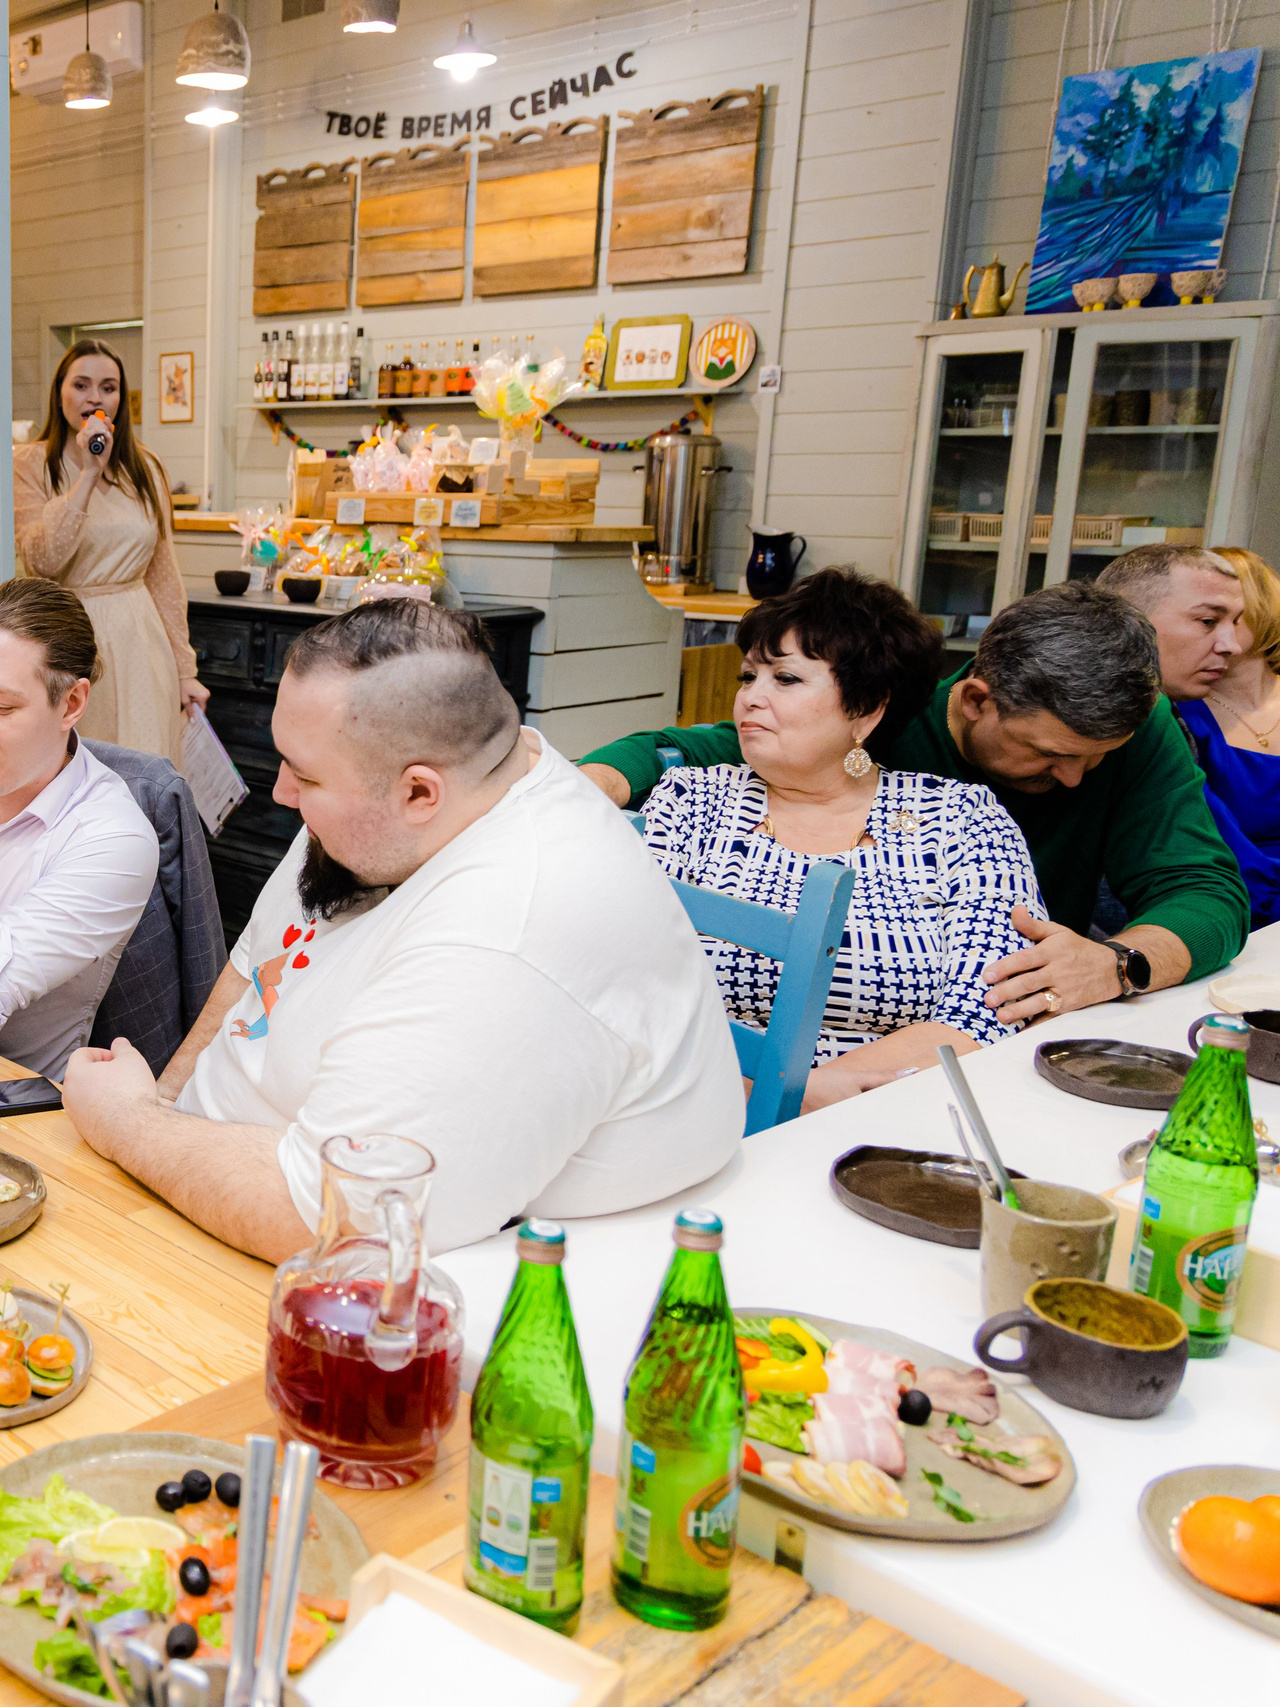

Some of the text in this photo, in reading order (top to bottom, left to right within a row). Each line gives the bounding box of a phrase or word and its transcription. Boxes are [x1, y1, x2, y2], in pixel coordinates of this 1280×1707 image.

[326, 51, 637, 139] ТВОЁ ВРЕМЯ СЕЙЧАС
